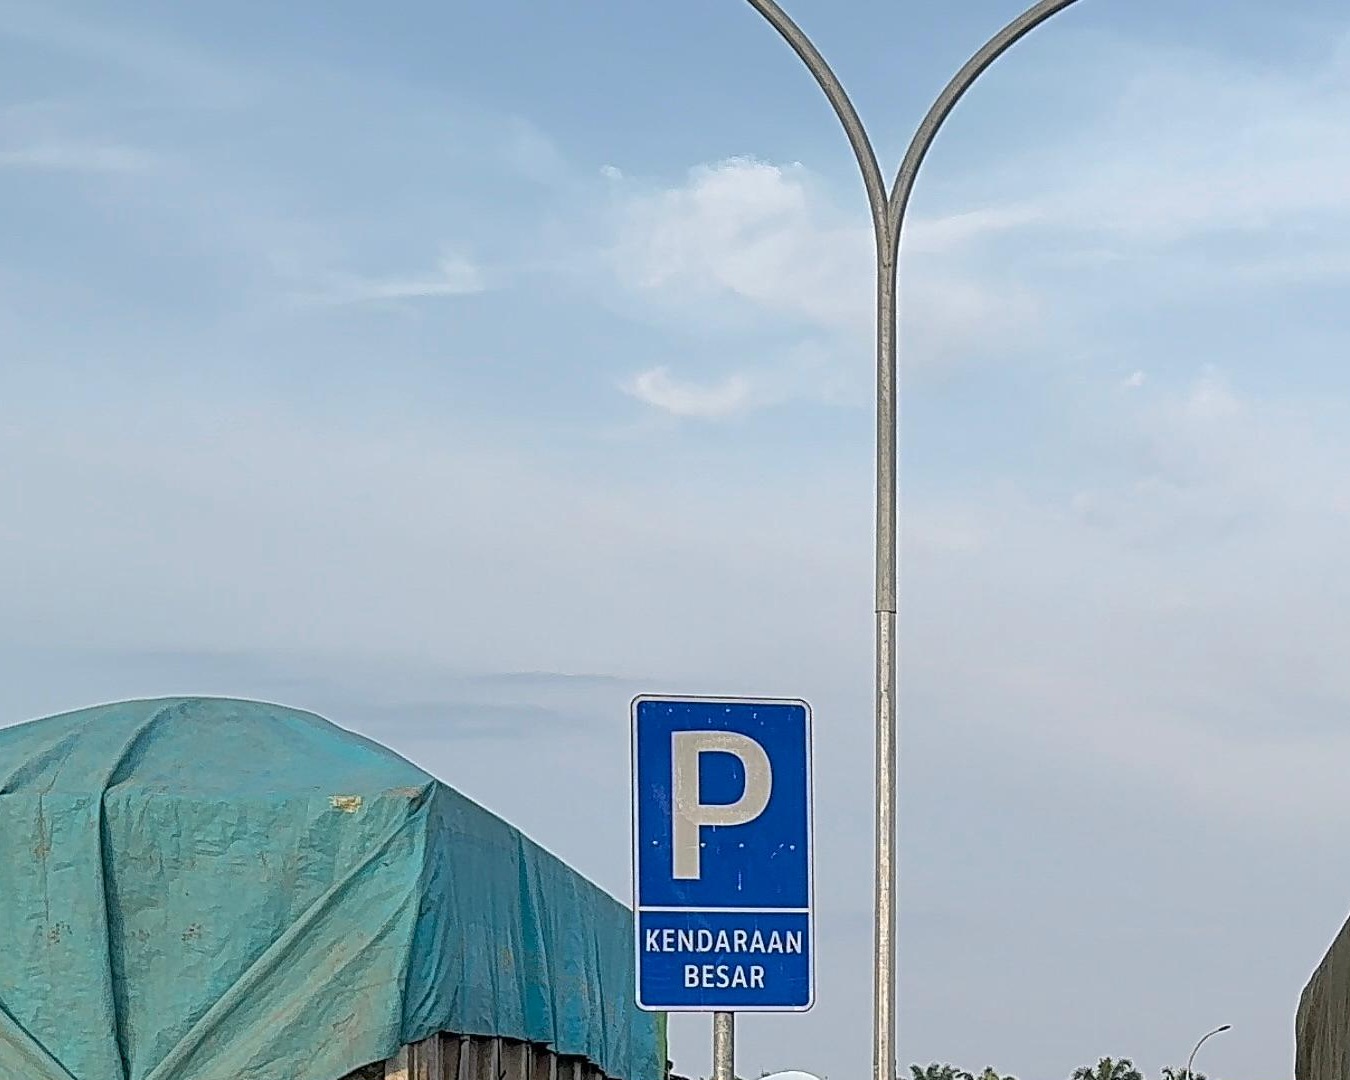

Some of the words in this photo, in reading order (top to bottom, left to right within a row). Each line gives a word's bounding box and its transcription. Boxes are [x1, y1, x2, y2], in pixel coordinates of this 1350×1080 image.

[672, 730, 772, 880] P
[645, 928, 802, 954] KENDARAAN
[684, 965, 765, 988] BESAR
